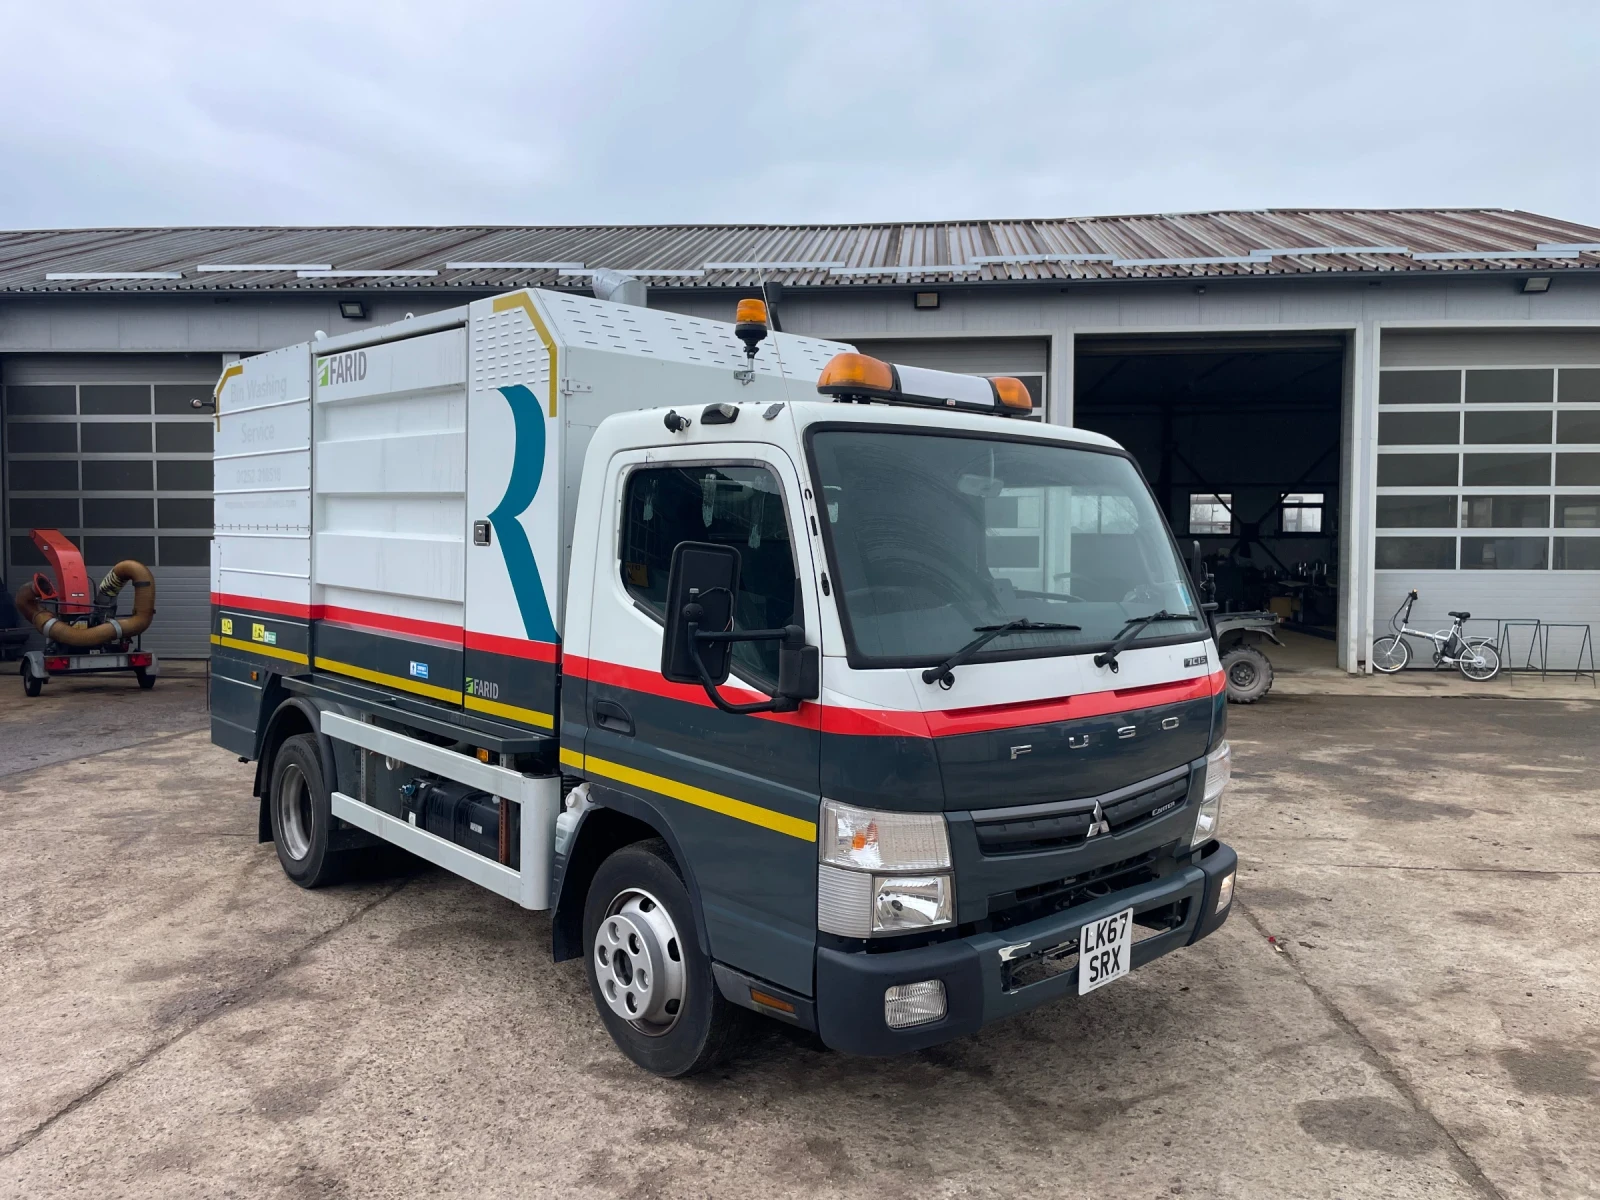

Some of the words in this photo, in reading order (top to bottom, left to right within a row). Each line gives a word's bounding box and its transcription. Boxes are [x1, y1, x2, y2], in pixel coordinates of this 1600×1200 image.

[329, 351, 367, 385] FARID
[230, 384, 244, 403] Bin
[247, 374, 287, 401] Washing
[241, 420, 275, 444] Service
[1187, 656, 1206, 666] 7C15
[473, 678, 499, 699] FARID
[1010, 716, 1180, 760] FUSO
[1084, 911, 1129, 954] LK67
[1089, 944, 1122, 983] SRX
